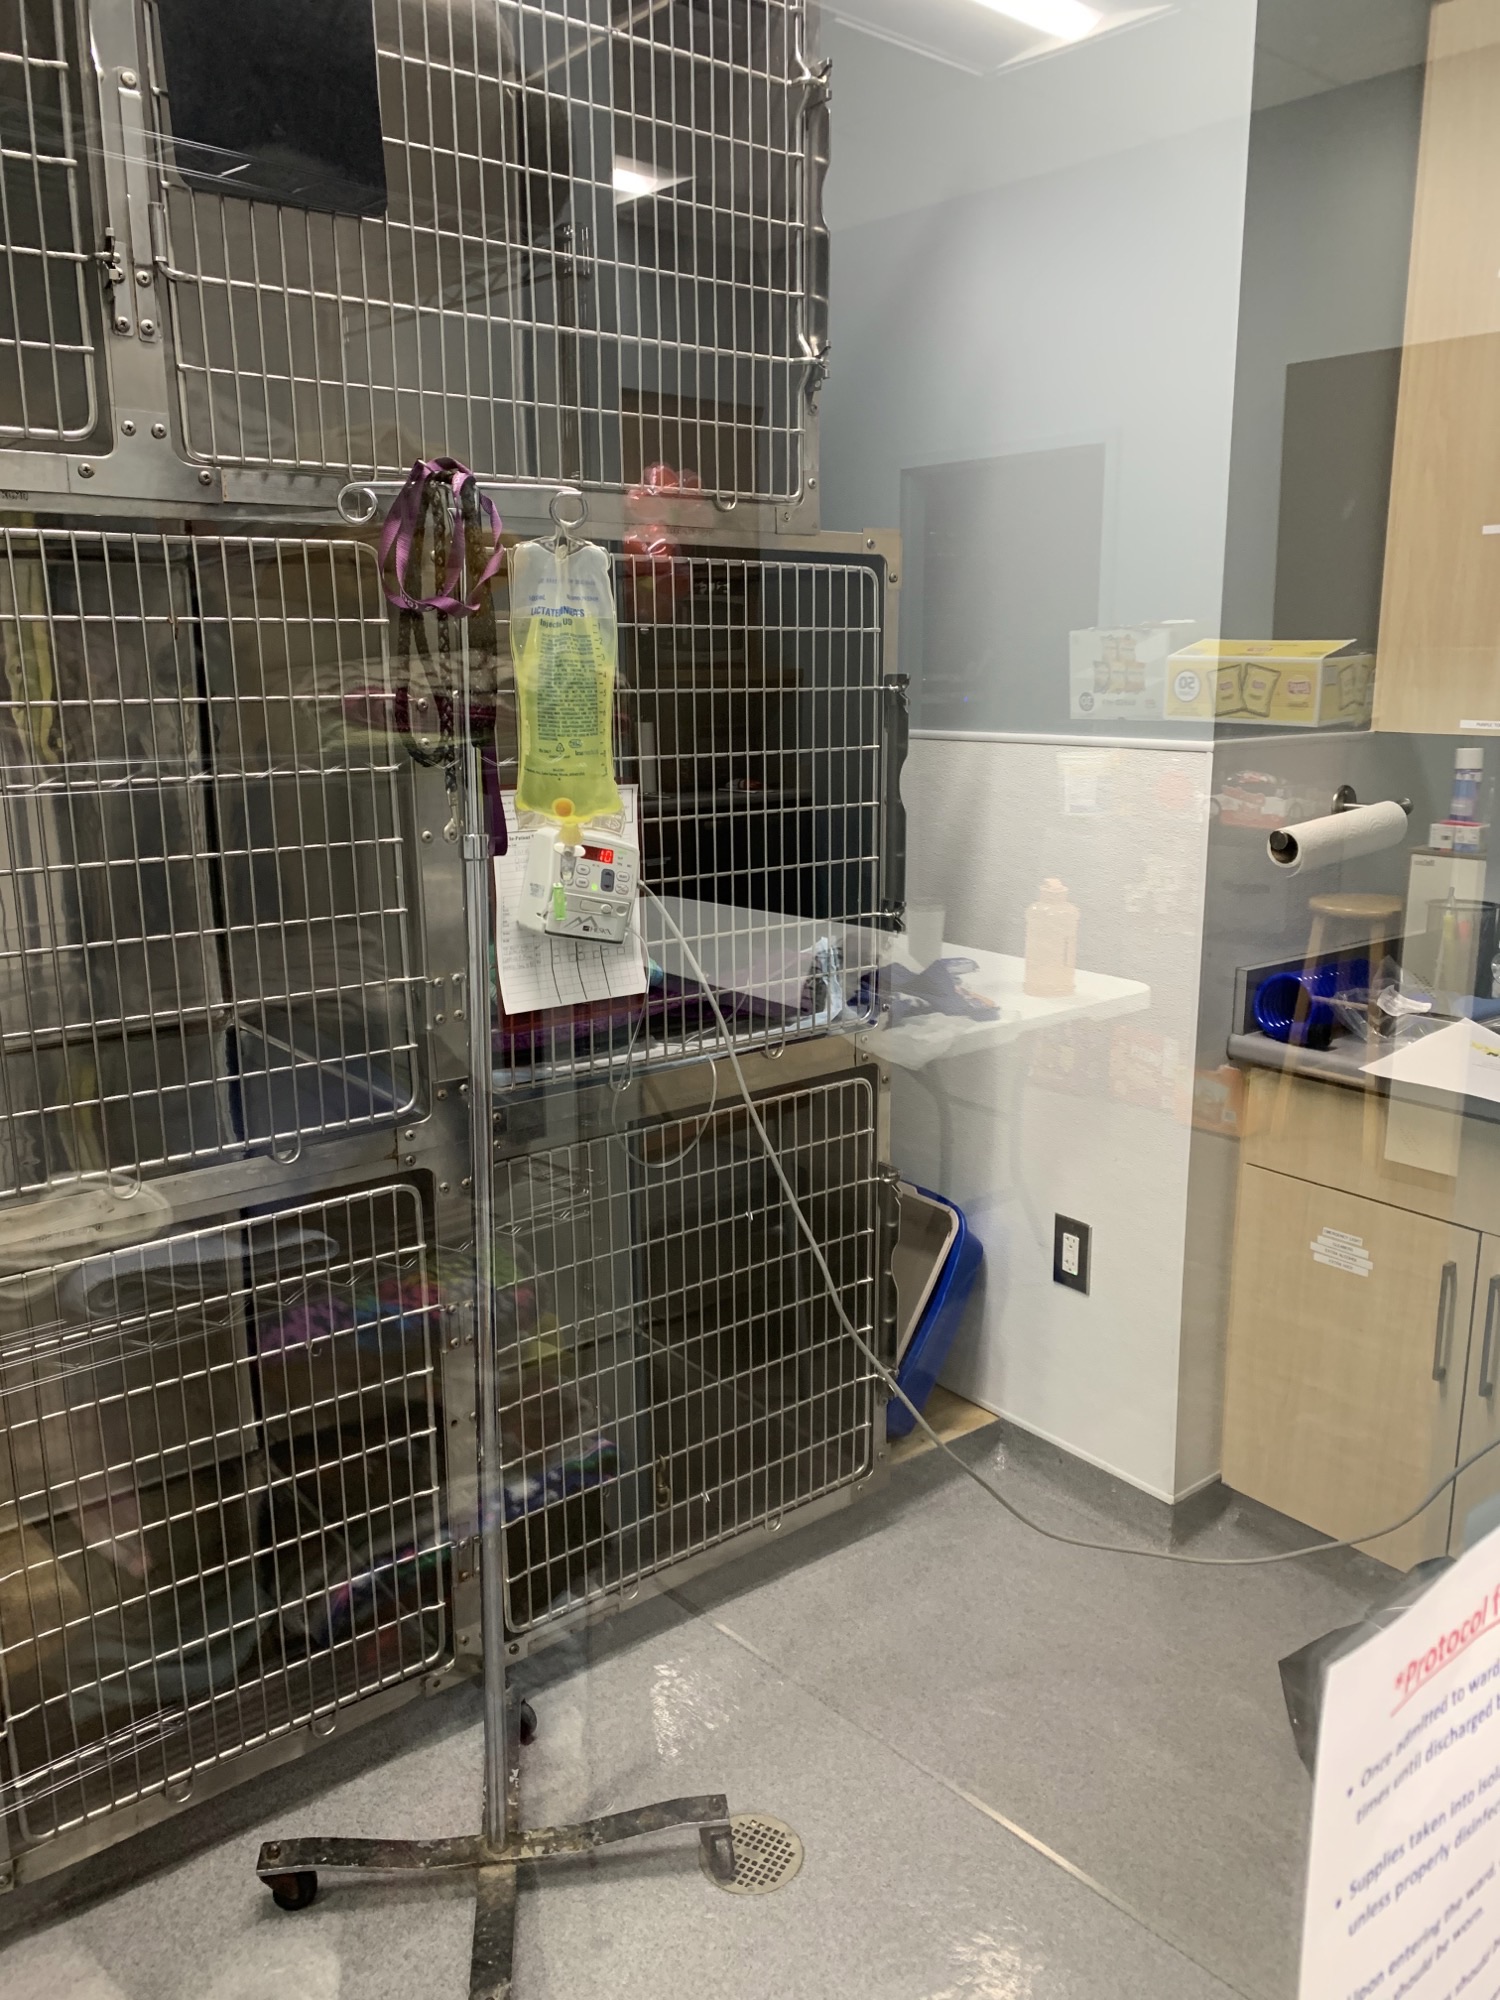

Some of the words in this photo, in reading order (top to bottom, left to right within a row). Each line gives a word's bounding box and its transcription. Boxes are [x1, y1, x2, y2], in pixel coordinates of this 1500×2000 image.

[599, 850, 613, 863] 10
[1356, 1784, 1391, 1825] times
[1393, 1751, 1423, 1790] until
[1424, 1696, 1494, 1765] discharged
[1360, 1750, 1394, 1788] Once
[1395, 1695, 1449, 1757] admitted
[1451, 1687, 1466, 1707] to
[1347, 1891, 1392, 1938] unless
[1394, 1843, 1451, 1902] properly
[1349, 1842, 1406, 1900] Supplies
[1408, 1812, 1447, 1850] taken
[1450, 1789, 1476, 1818] into
[1388, 1918, 1442, 1976] entering
[1443, 1896, 1463, 1923] the
